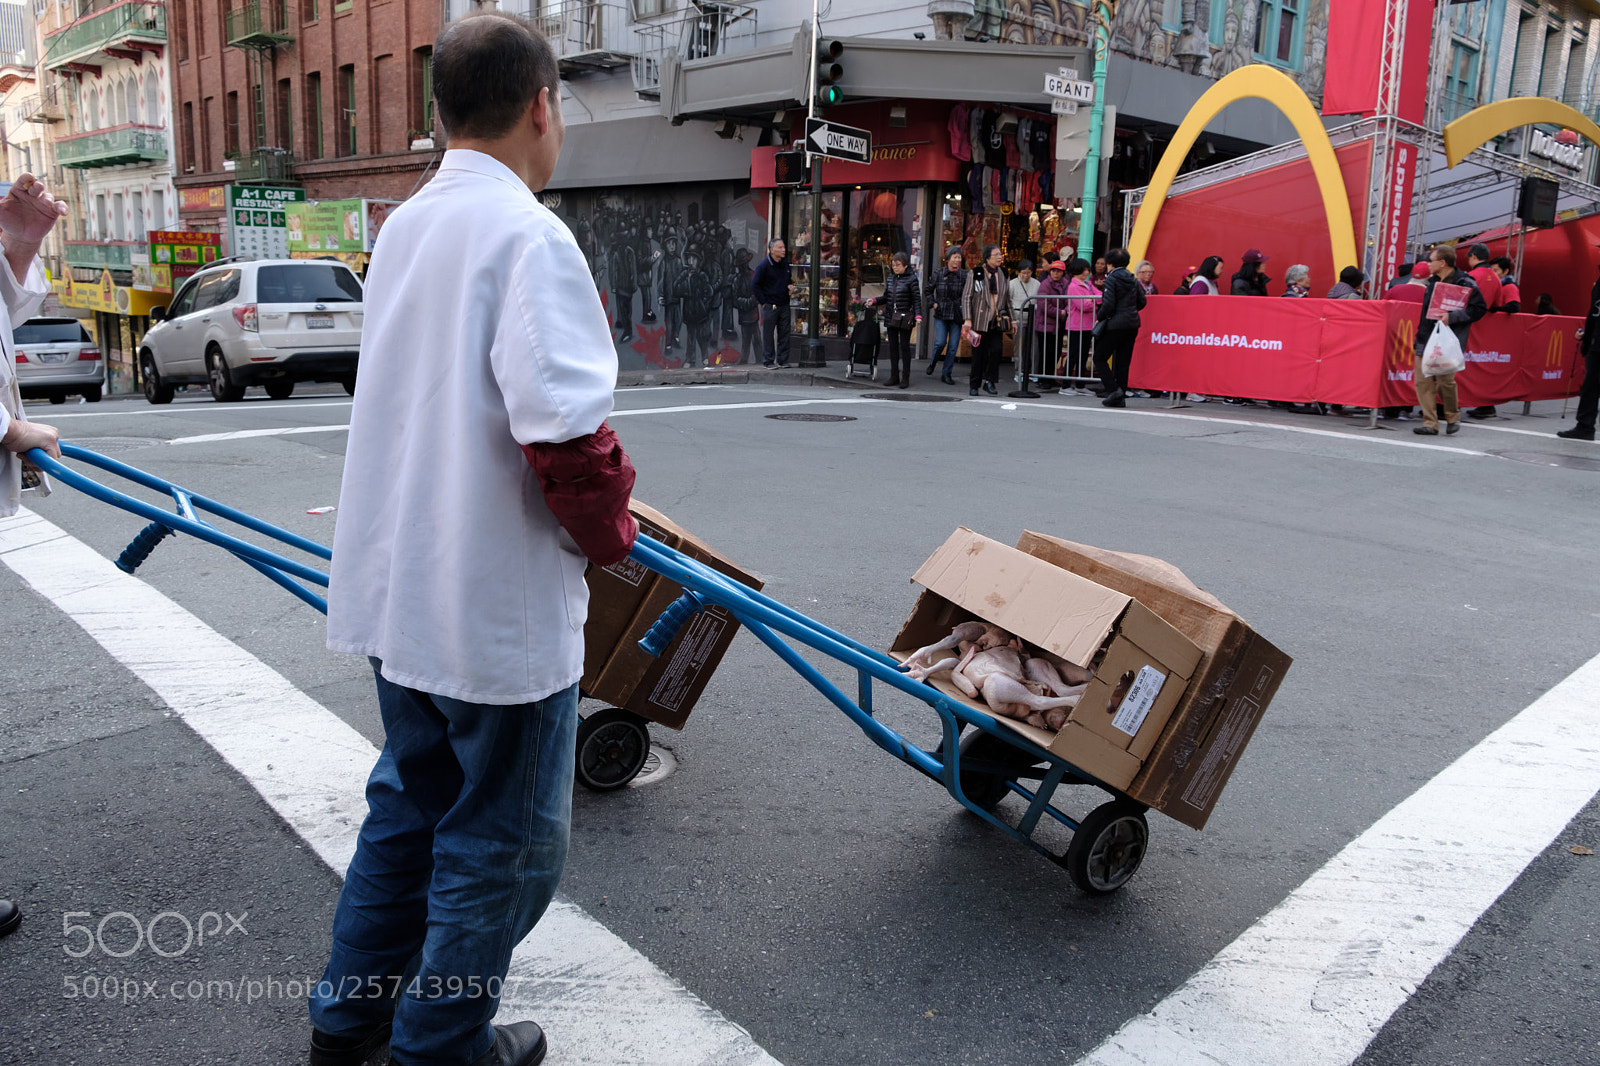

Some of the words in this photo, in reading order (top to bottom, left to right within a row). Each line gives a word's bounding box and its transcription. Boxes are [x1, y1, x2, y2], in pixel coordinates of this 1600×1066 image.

[1049, 79, 1090, 98] GRANT
[827, 133, 844, 148] ONE
[847, 138, 865, 152] WAY
[241, 189, 260, 199] A-1
[264, 190, 296, 201] CAFE
[1385, 148, 1407, 291] cDonald's
[1151, 332, 1282, 350] McDonaldsAPA.com
